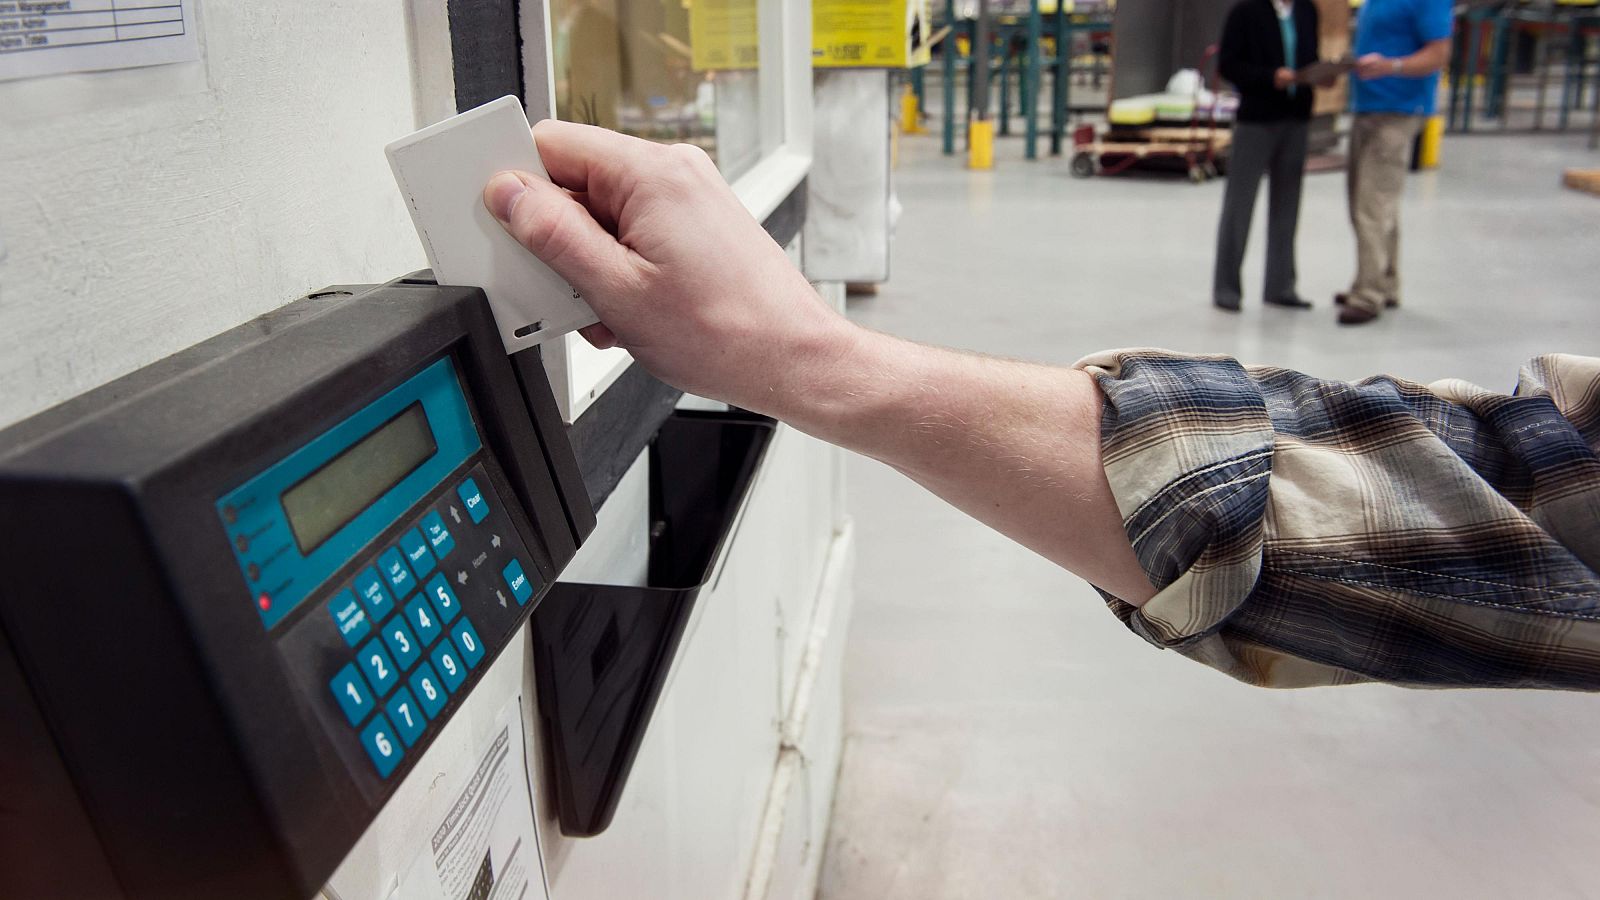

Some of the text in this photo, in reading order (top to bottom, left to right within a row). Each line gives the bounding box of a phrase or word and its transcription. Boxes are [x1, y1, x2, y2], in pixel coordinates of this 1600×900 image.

[466, 493, 481, 508] Clear
[472, 552, 487, 568] Home
[511, 574, 524, 591] Enter
[436, 586, 451, 608] 5
[418, 607, 431, 628] 4
[394, 630, 410, 653] 3
[461, 631, 475, 652] 0
[371, 654, 388, 680] 2
[442, 654, 456, 676] 9
[347, 682, 362, 705] 1
[421, 678, 437, 701] 8
[398, 702, 414, 727] 7
[375, 731, 393, 757] 6
